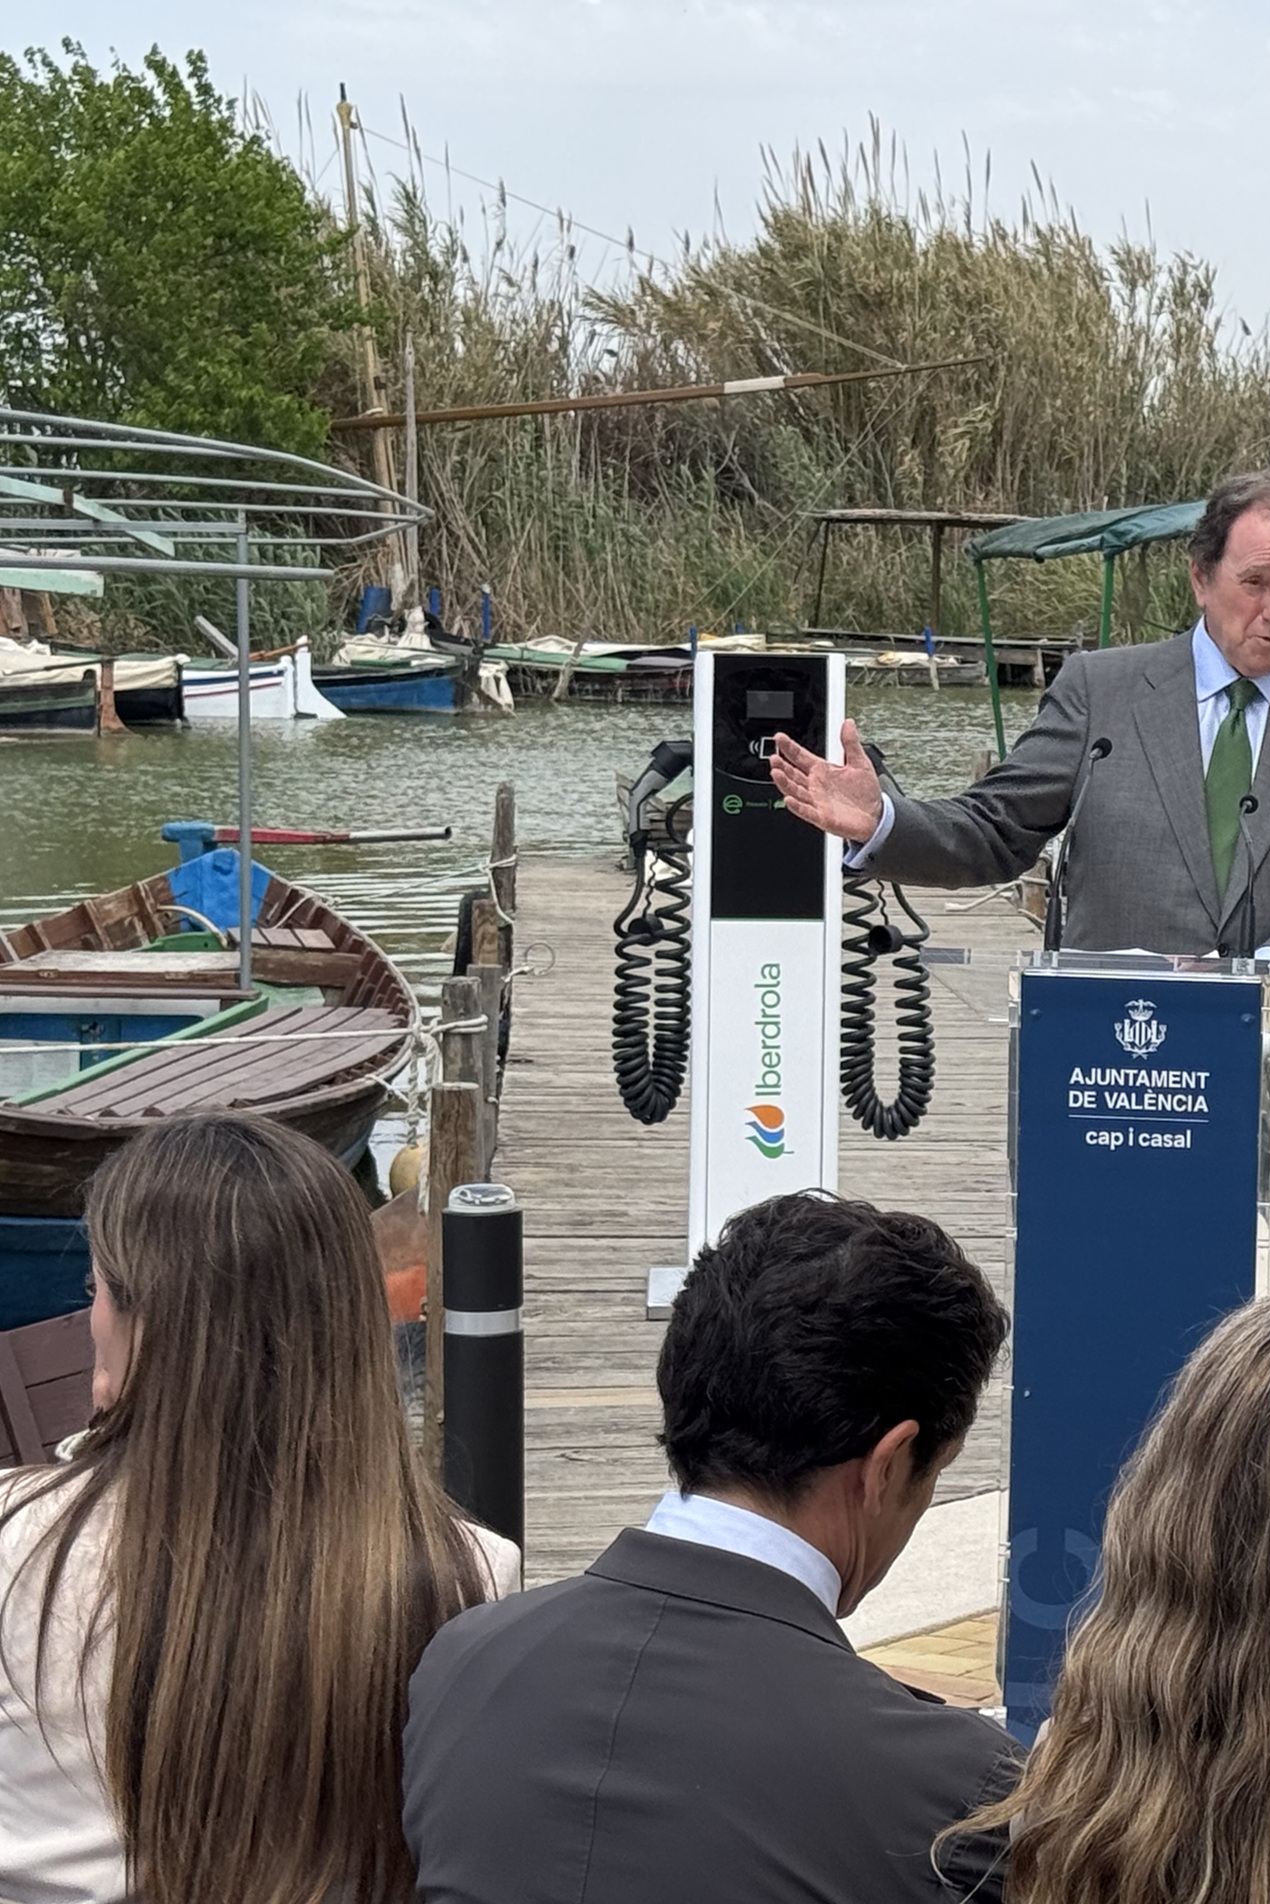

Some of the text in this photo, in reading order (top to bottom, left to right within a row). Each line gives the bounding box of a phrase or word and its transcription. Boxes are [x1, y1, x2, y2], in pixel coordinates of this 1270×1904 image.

[754, 962, 782, 1096] Iberdrola
[1069, 1067, 1210, 1089] AJUNTAMENT
[1068, 1089, 1209, 1112] DE VALÈNCIA
[1085, 1127, 1192, 1150] cap i casal
